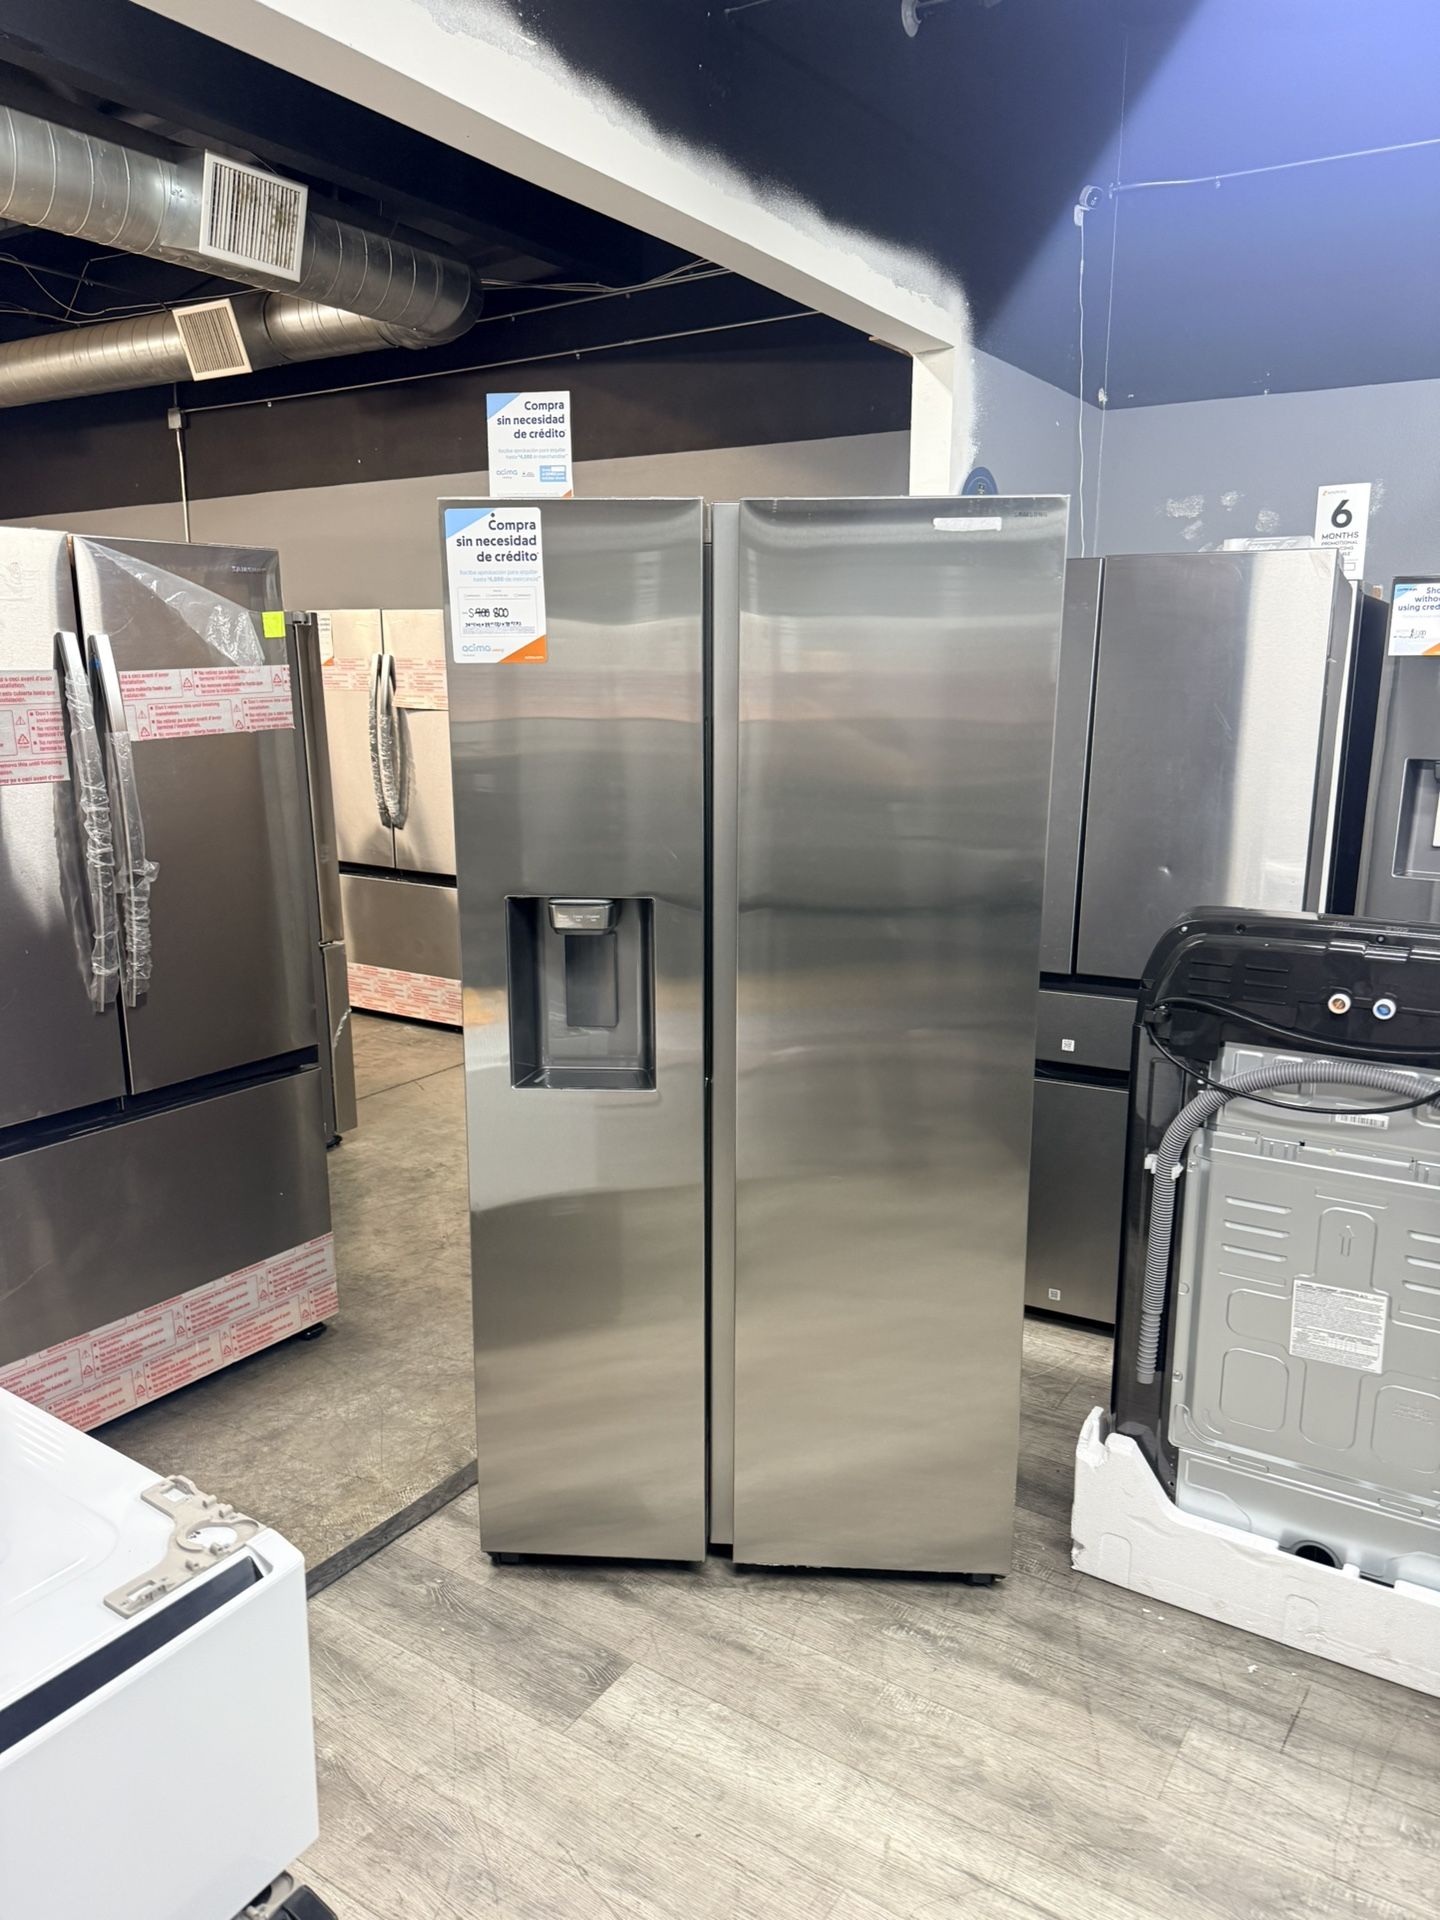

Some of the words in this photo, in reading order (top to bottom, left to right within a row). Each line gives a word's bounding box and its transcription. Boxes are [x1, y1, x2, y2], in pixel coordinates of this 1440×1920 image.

[524, 401, 565, 412] Compra
[496, 415, 511, 425] sin
[513, 414, 565, 425] necesidad
[513, 429, 527, 439] de
[529, 428, 566, 439] crédito
[1331, 498, 1353, 529] 6
[488, 519, 536, 533] Compra
[456, 535, 473, 547] sin
[475, 534, 537, 547] necesidad
[1321, 531, 1359, 541] MONTHS
[476, 551, 492, 562] de
[494, 550, 538, 562] crédito
[1398, 604, 1421, 612] using
[462, 643, 491, 652] acima
